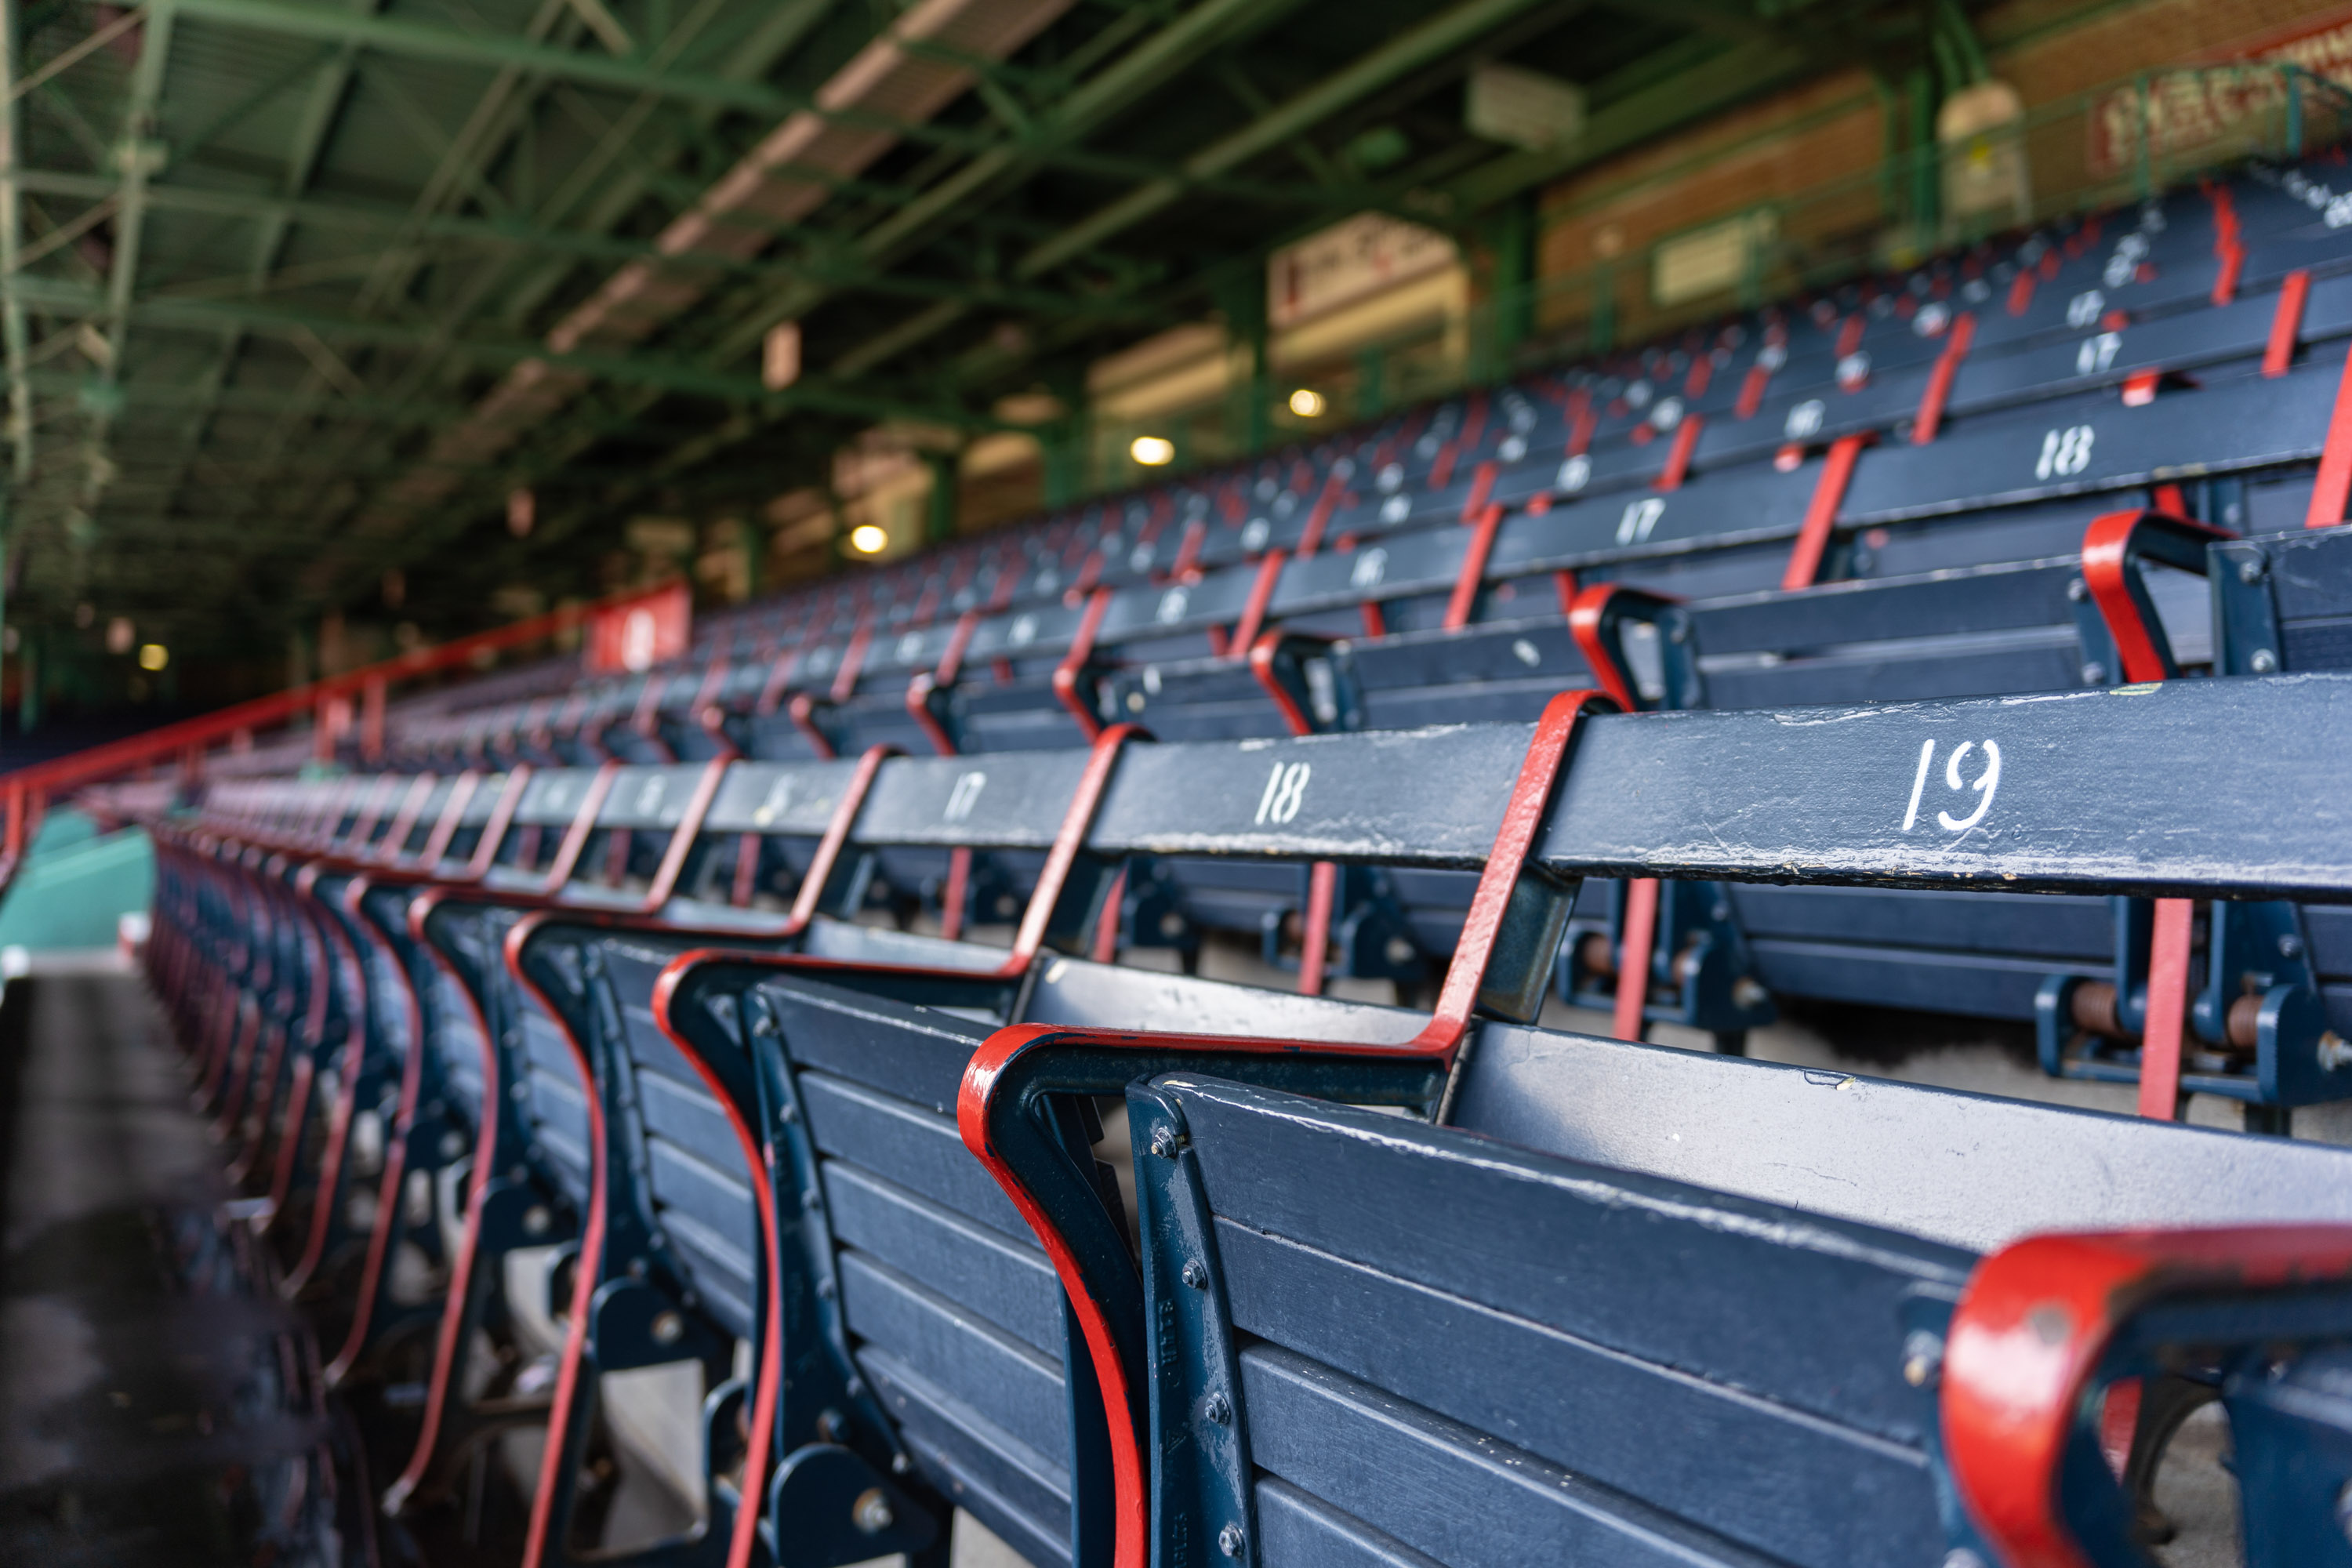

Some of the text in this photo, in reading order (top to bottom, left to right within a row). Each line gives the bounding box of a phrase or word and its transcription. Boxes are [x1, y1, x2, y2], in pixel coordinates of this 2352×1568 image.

[2034, 424, 2095, 481] 18
[1615, 497, 1667, 546] 17
[943, 771, 987, 822] 17
[1255, 760, 1311, 826] 18
[1903, 739, 2000, 830] 19
